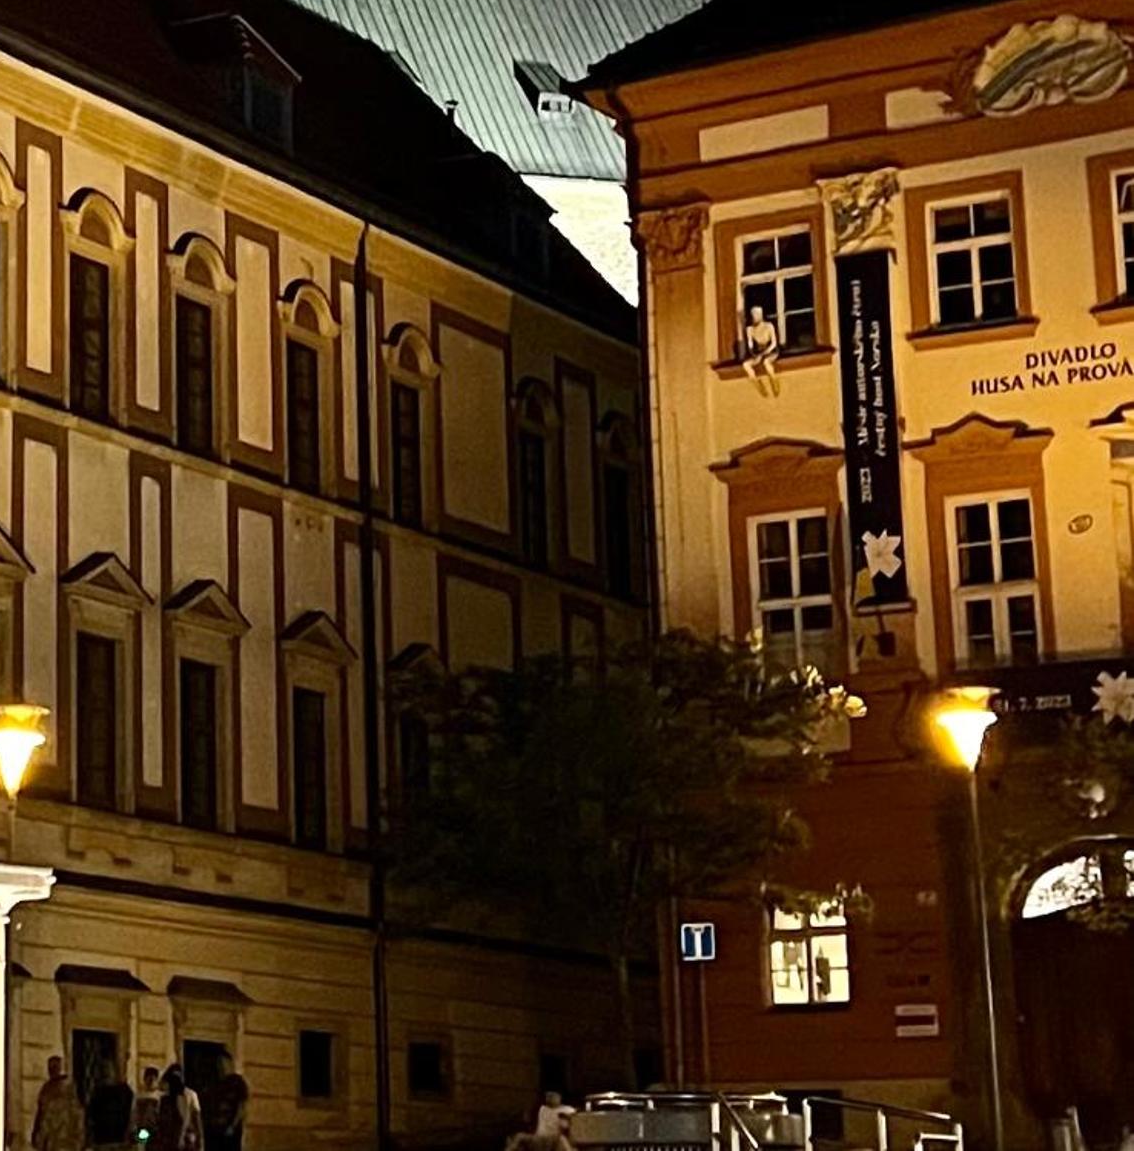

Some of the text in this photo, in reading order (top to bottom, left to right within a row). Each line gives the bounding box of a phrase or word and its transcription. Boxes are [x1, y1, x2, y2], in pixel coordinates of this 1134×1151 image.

[1025, 342, 1117, 370] DIVADLO
[971, 374, 1024, 396] HUSA
[1032, 370, 1060, 389] NA
